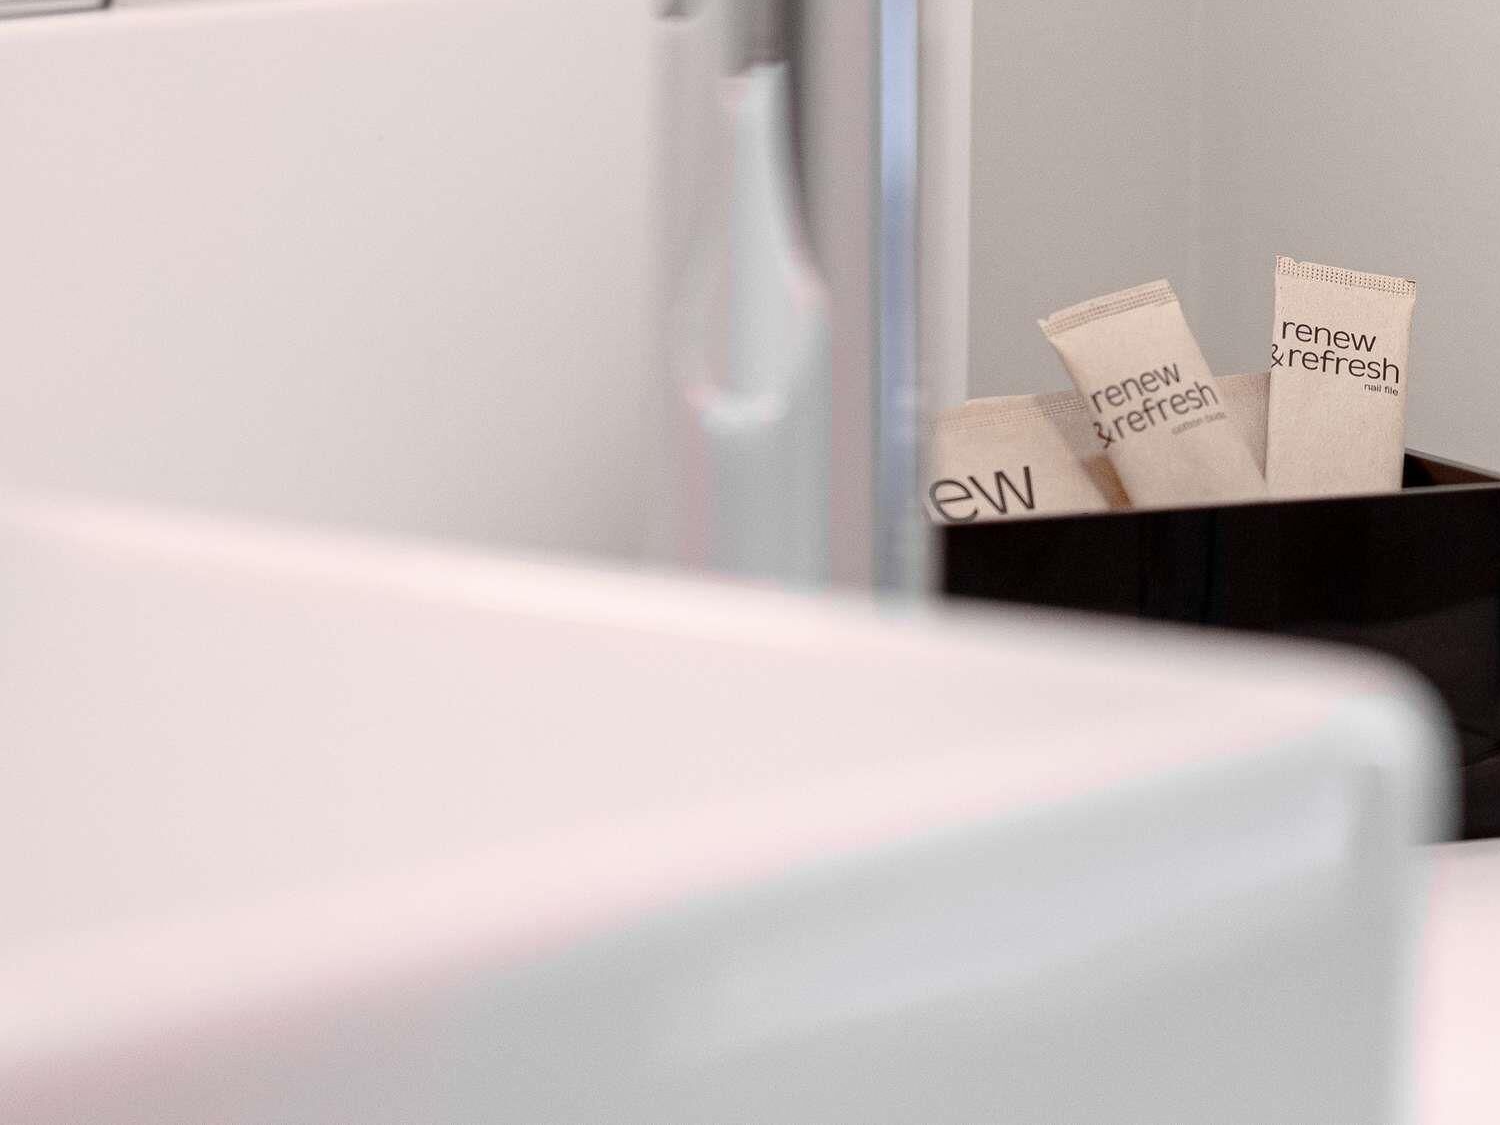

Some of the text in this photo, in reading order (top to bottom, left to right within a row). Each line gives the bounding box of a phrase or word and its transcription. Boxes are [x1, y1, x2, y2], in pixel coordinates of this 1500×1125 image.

[1282, 320, 1376, 353] renew
[1090, 363, 1180, 413] renew
[1363, 382, 1399, 397] nail file
